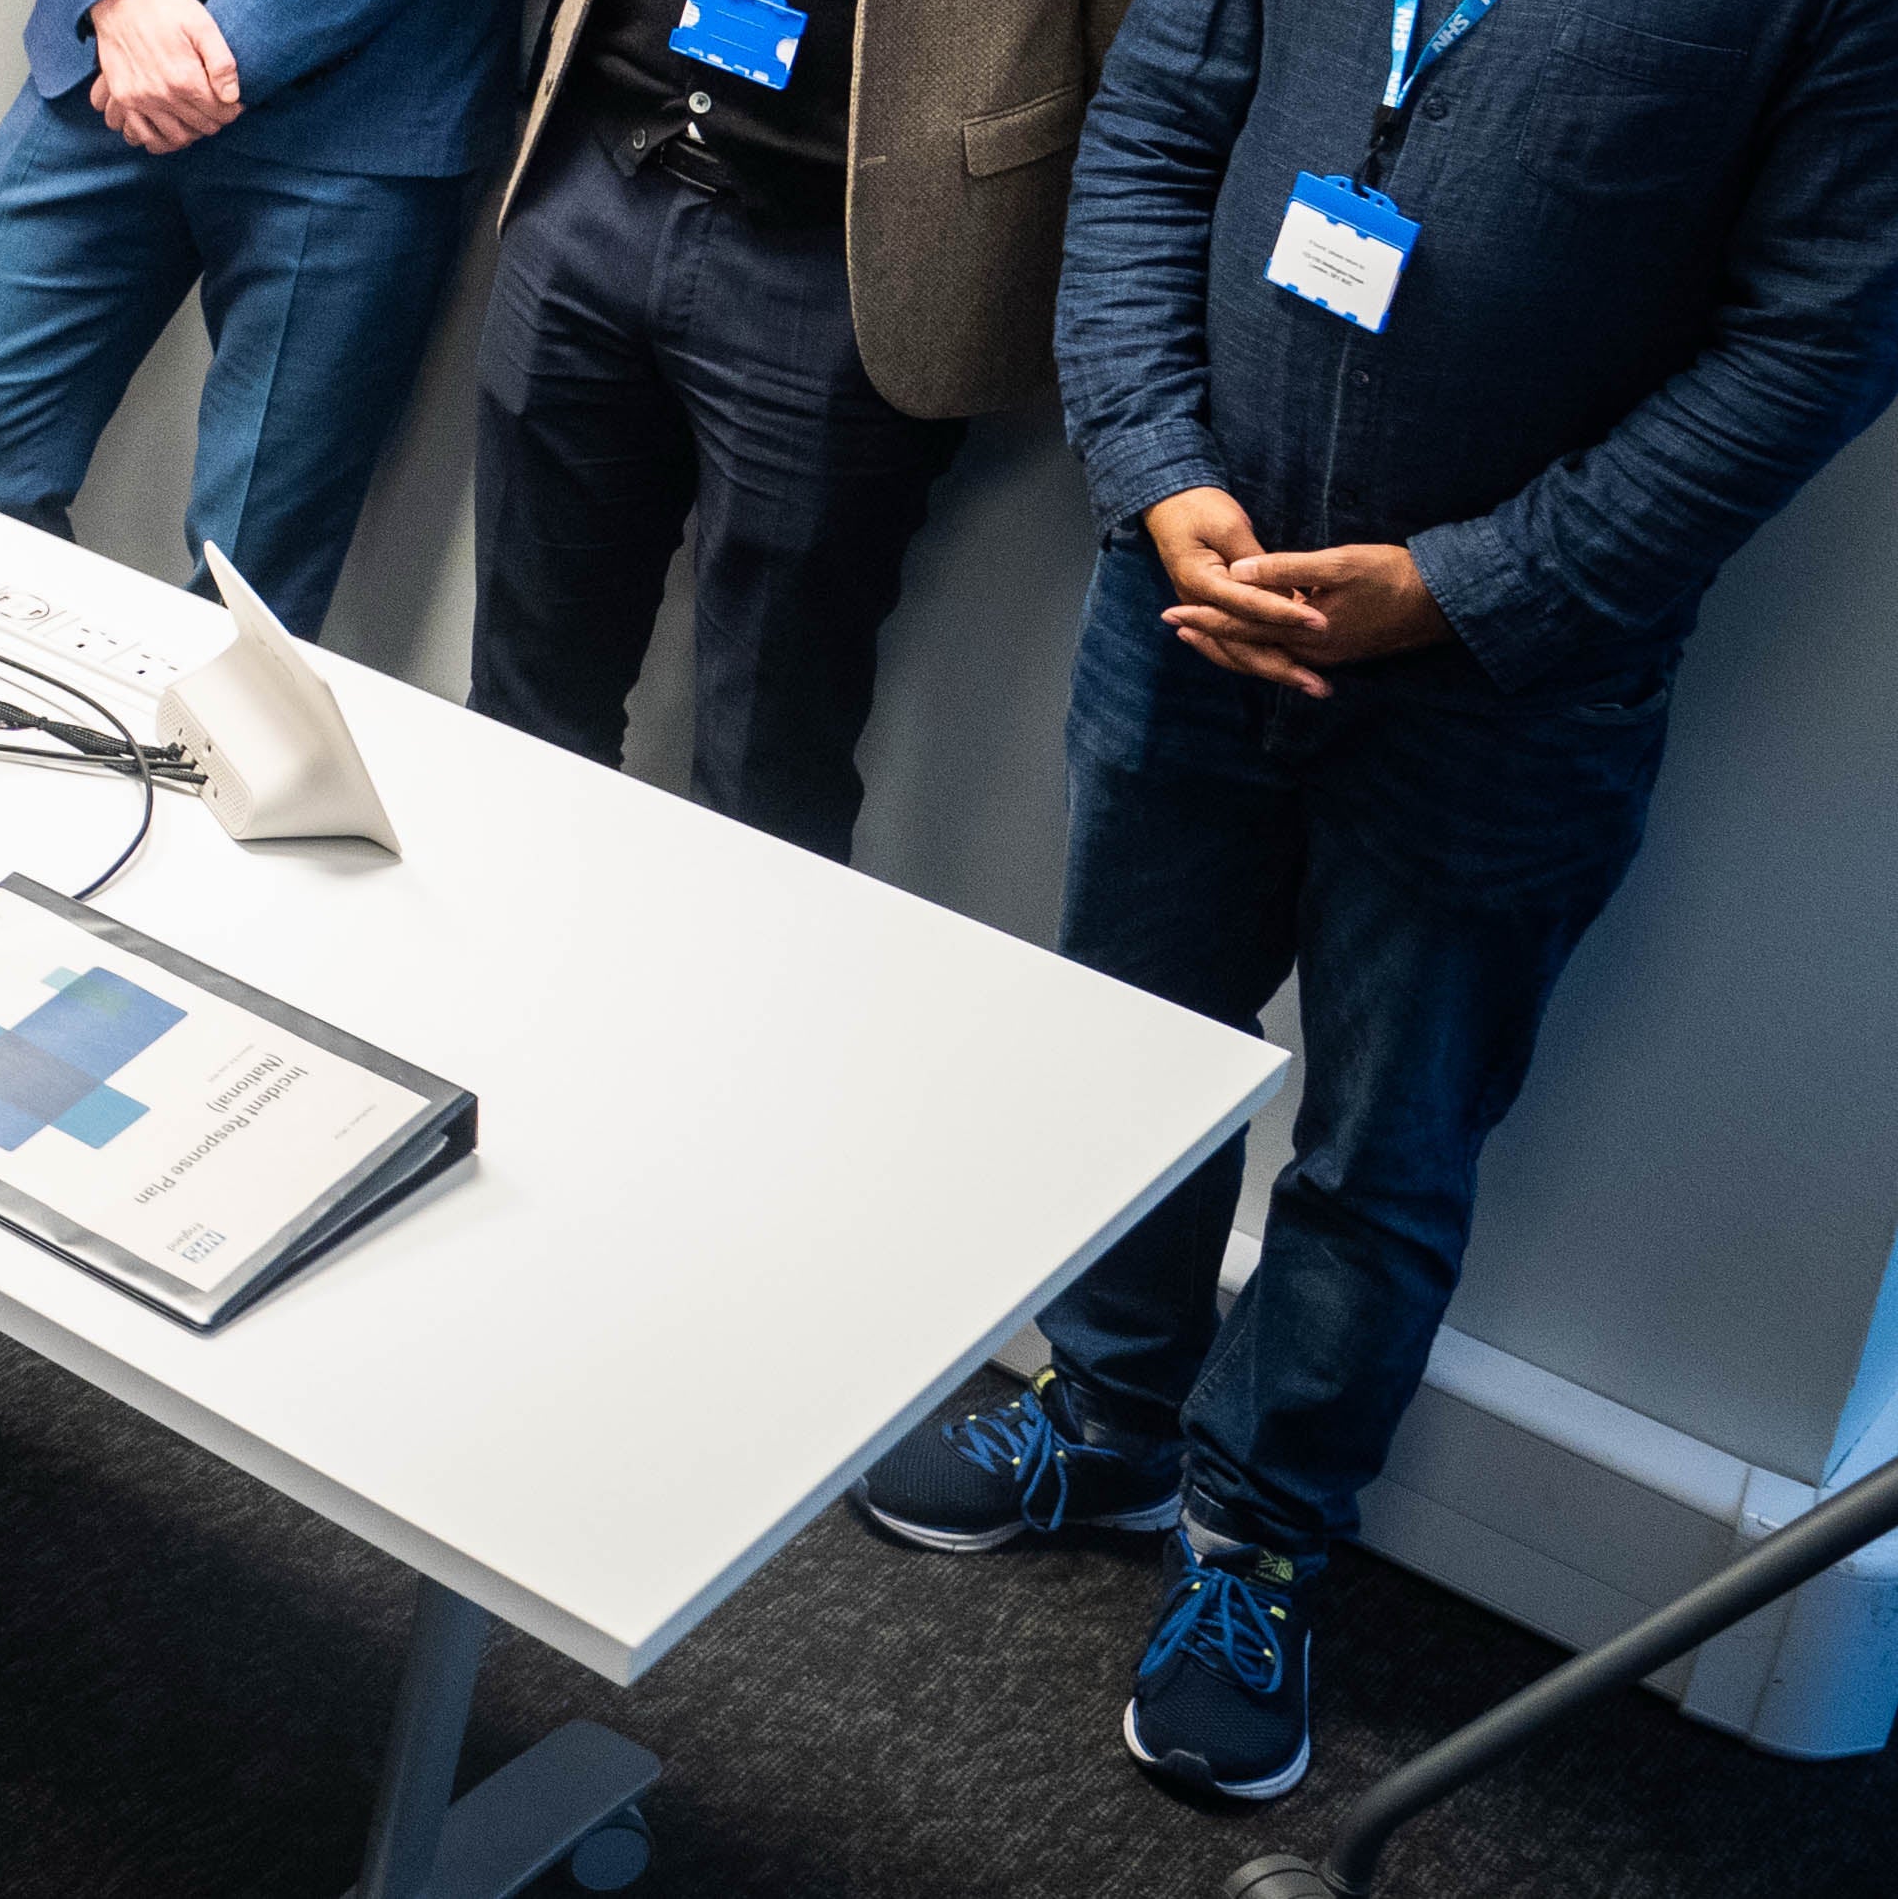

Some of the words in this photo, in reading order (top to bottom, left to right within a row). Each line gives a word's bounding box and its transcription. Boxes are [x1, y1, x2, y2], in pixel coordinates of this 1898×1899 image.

[1391, 6, 1414, 53] NHS
[1430, 13, 1470, 54] NHS
[204, 1051, 283, 1116] (National)
[243, 1063, 308, 1121] Incident
[169, 1110, 249, 1178] Response
[132, 1172, 177, 1207] Plan
[164, 1220, 204, 1253] England
[179, 1228, 223, 1266] NHS
